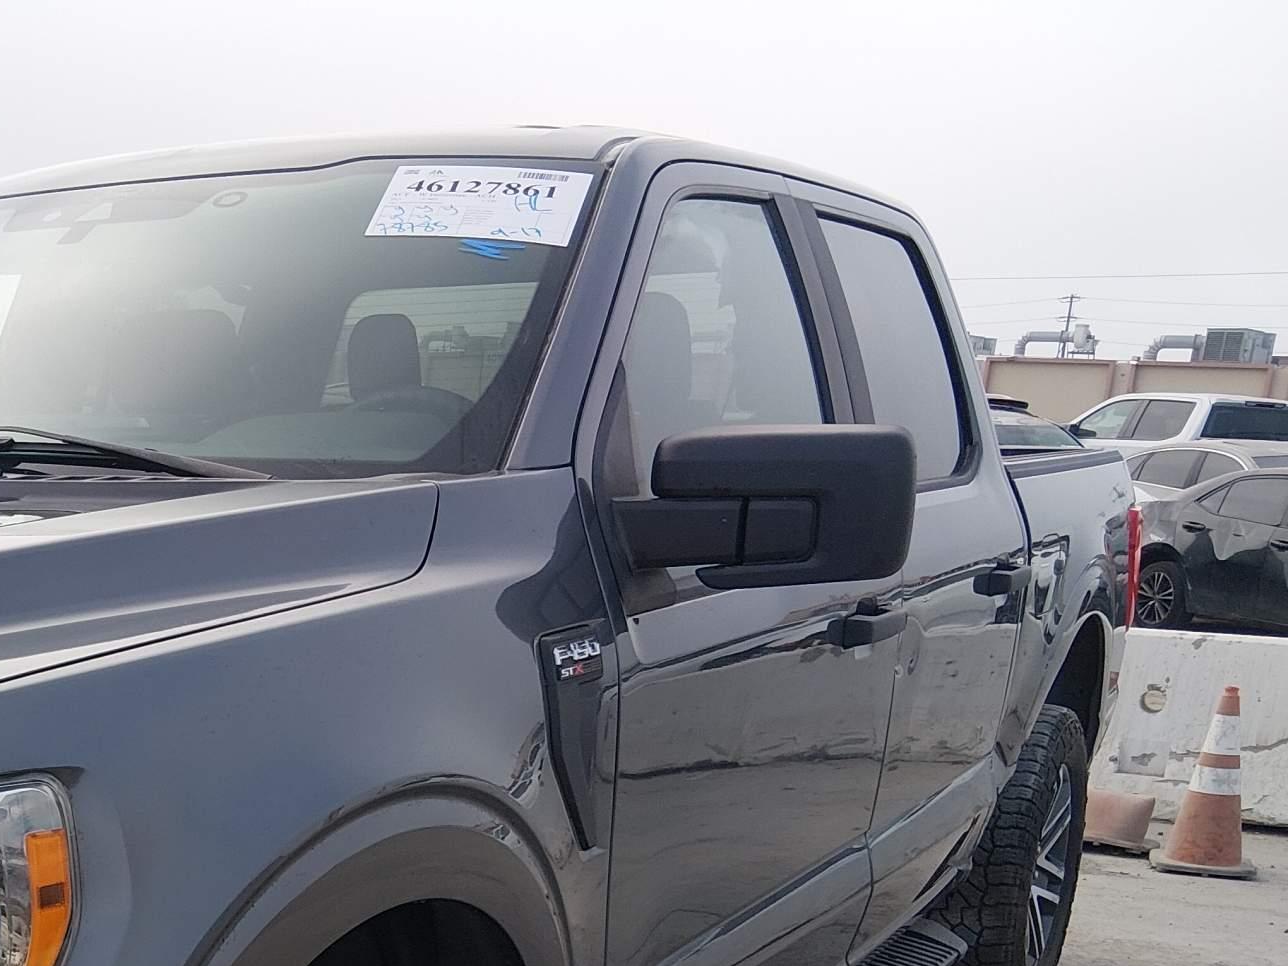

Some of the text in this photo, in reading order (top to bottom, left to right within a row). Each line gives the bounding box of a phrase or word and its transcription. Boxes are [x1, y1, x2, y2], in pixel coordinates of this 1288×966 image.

[406, 179, 557, 198] 46127861
[553, 640, 601, 666] F-150
[560, 663, 585, 678] STX
